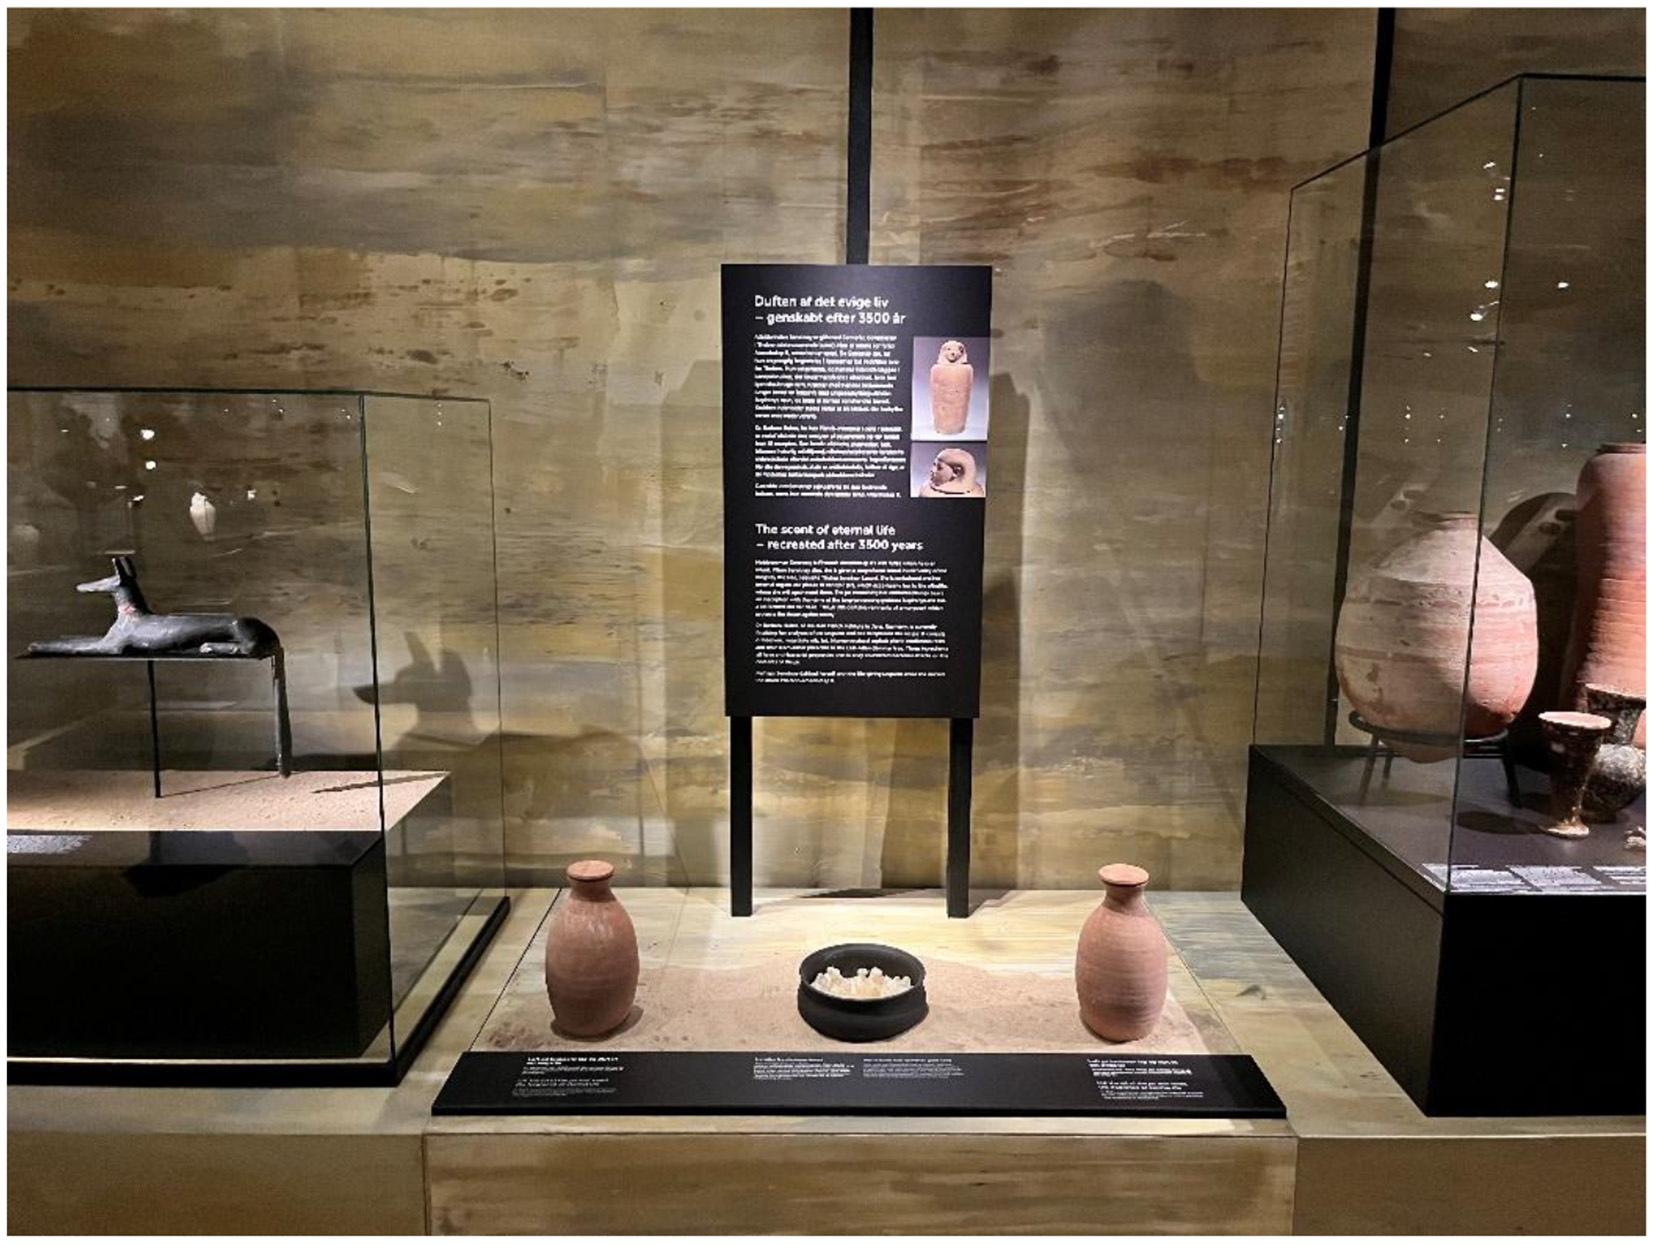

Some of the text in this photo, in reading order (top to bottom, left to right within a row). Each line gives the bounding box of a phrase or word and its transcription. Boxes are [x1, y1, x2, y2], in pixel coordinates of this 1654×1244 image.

[755, 295, 889, 310] Duften af det evige liv
[766, 312, 823, 325] genskabt
[825, 312, 856, 324] efter
[858, 312, 890, 324] 3500
[892, 312, 906, 324] år
[755, 523, 896, 536] The scent of eternal life
[767, 539, 825, 550] recreated
[827, 539, 857, 550] after
[858, 539, 889, 550] 3500
[891, 541, 924, 553] years
